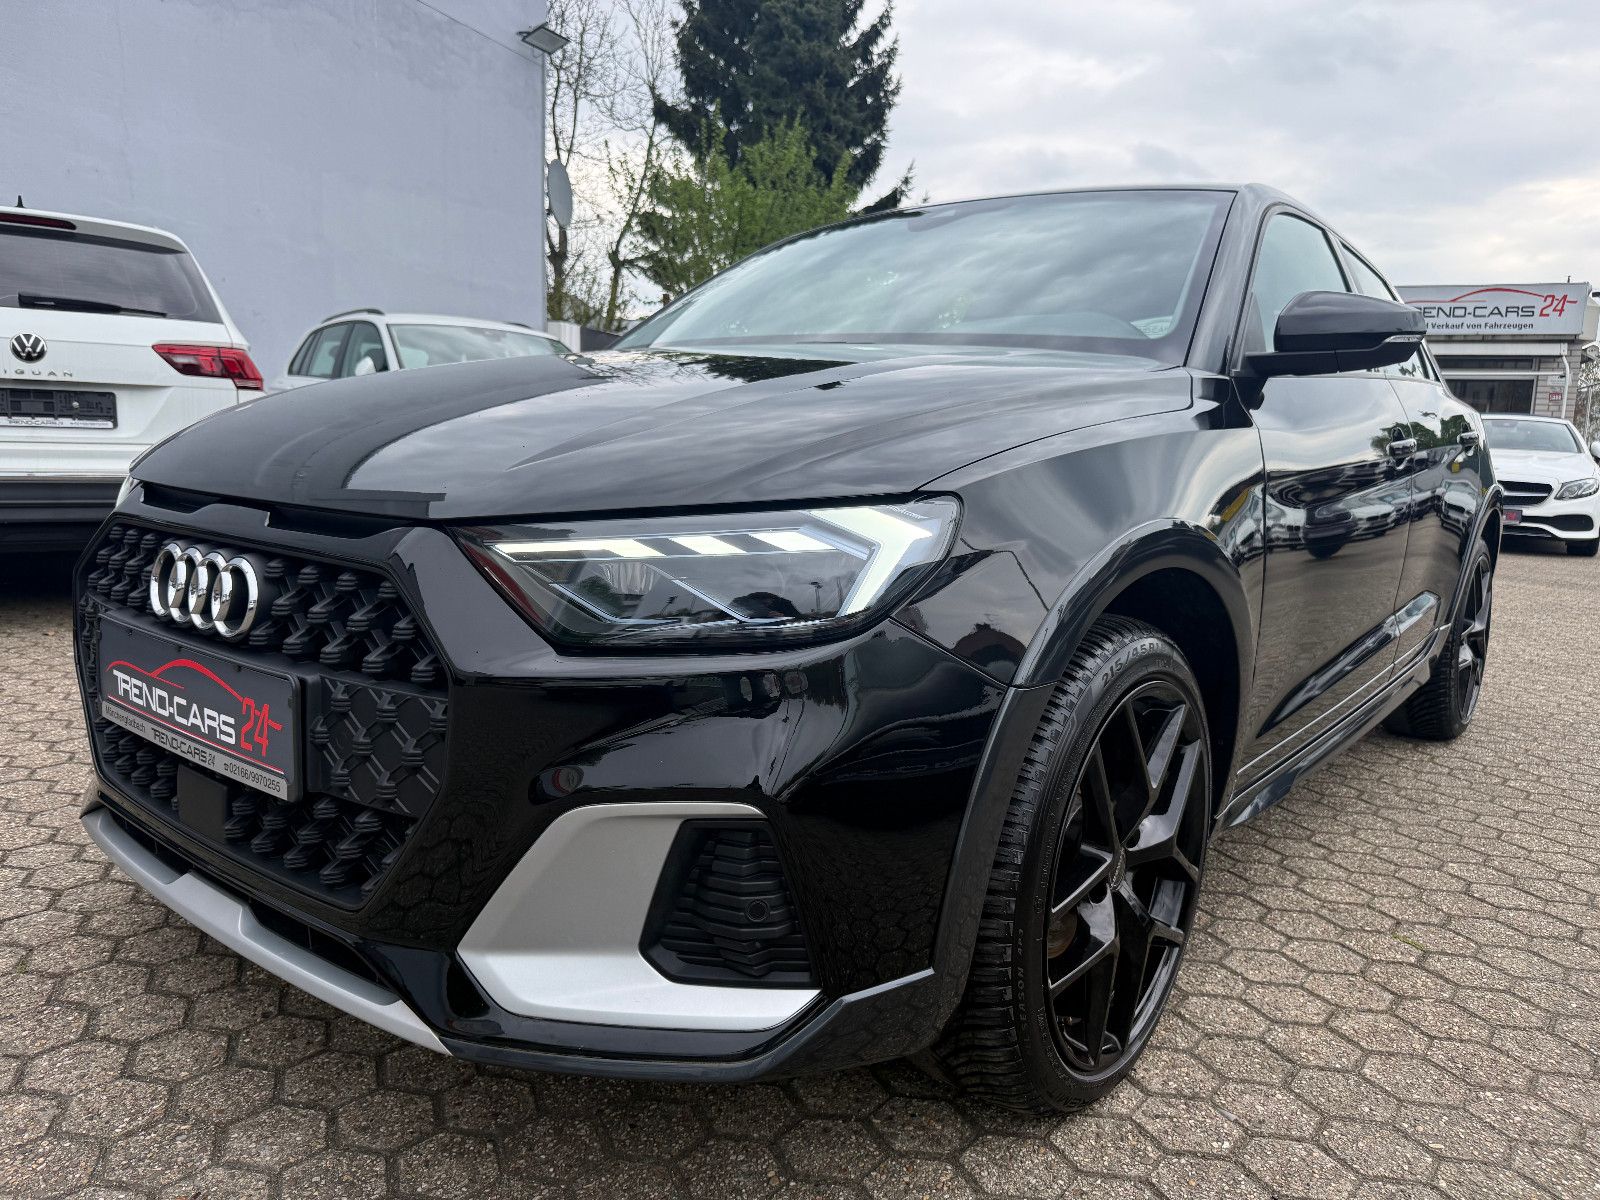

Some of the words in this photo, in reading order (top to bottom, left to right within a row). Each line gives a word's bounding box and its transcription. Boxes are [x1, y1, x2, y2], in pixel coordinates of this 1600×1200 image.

[1413, 306, 1535, 318] END-CARS
[1538, 294, 1578, 318] 24
[1431, 321, 1464, 330] Verkauf
[1484, 321, 1534, 331] Fahrzeugen
[0, 368, 73, 378] IGUAN
[112, 669, 236, 745] TREND-CARS
[240, 696, 283, 757] 24
[151, 727, 208, 763] TREND-CARS
[207, 752, 216, 768] 24
[229, 761, 282, 793] 02166/9970255
